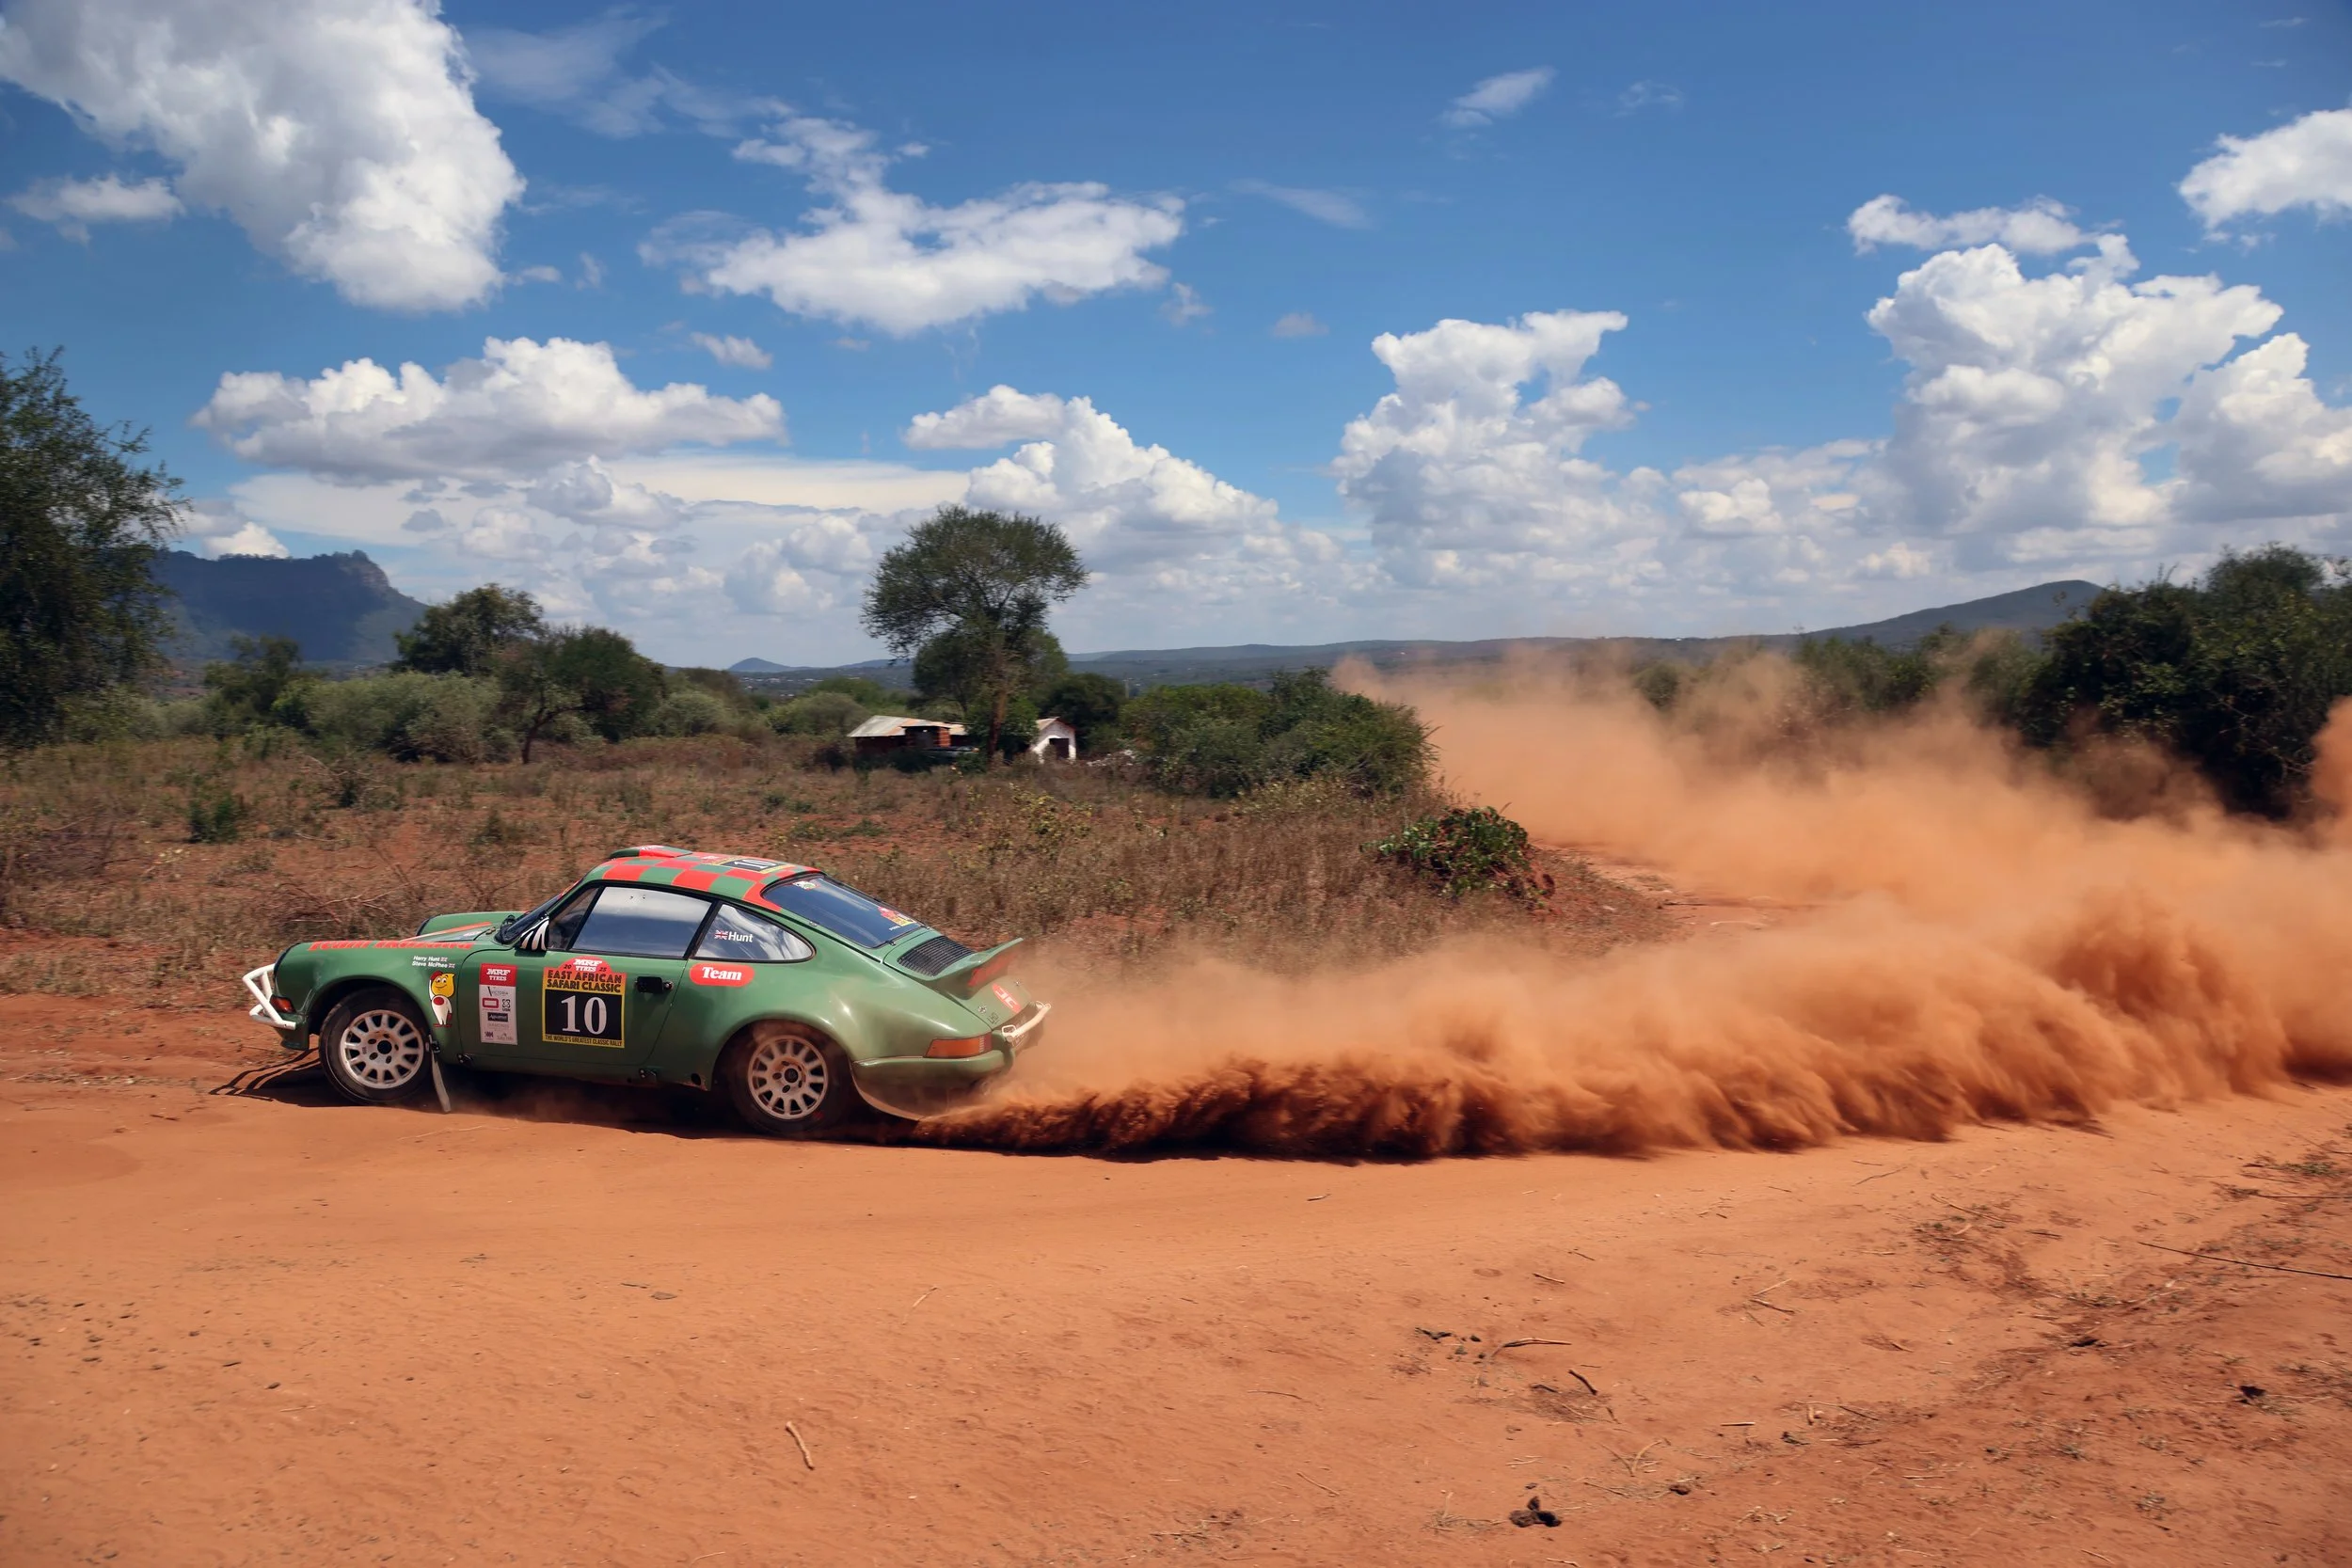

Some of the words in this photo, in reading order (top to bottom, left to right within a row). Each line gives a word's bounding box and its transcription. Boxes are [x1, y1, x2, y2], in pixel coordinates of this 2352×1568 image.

[728, 931, 754, 942] Hunt
[573, 958, 602, 967] MRF
[486, 968, 511, 976] MRF
[548, 970, 572, 980] EAST
[575, 972, 622, 984] AFRICAN
[702, 966, 742, 981] Team
[547, 979, 580, 990] SAFARI
[581, 982, 621, 993] CLASSIC
[561, 995, 607, 1035] 10
